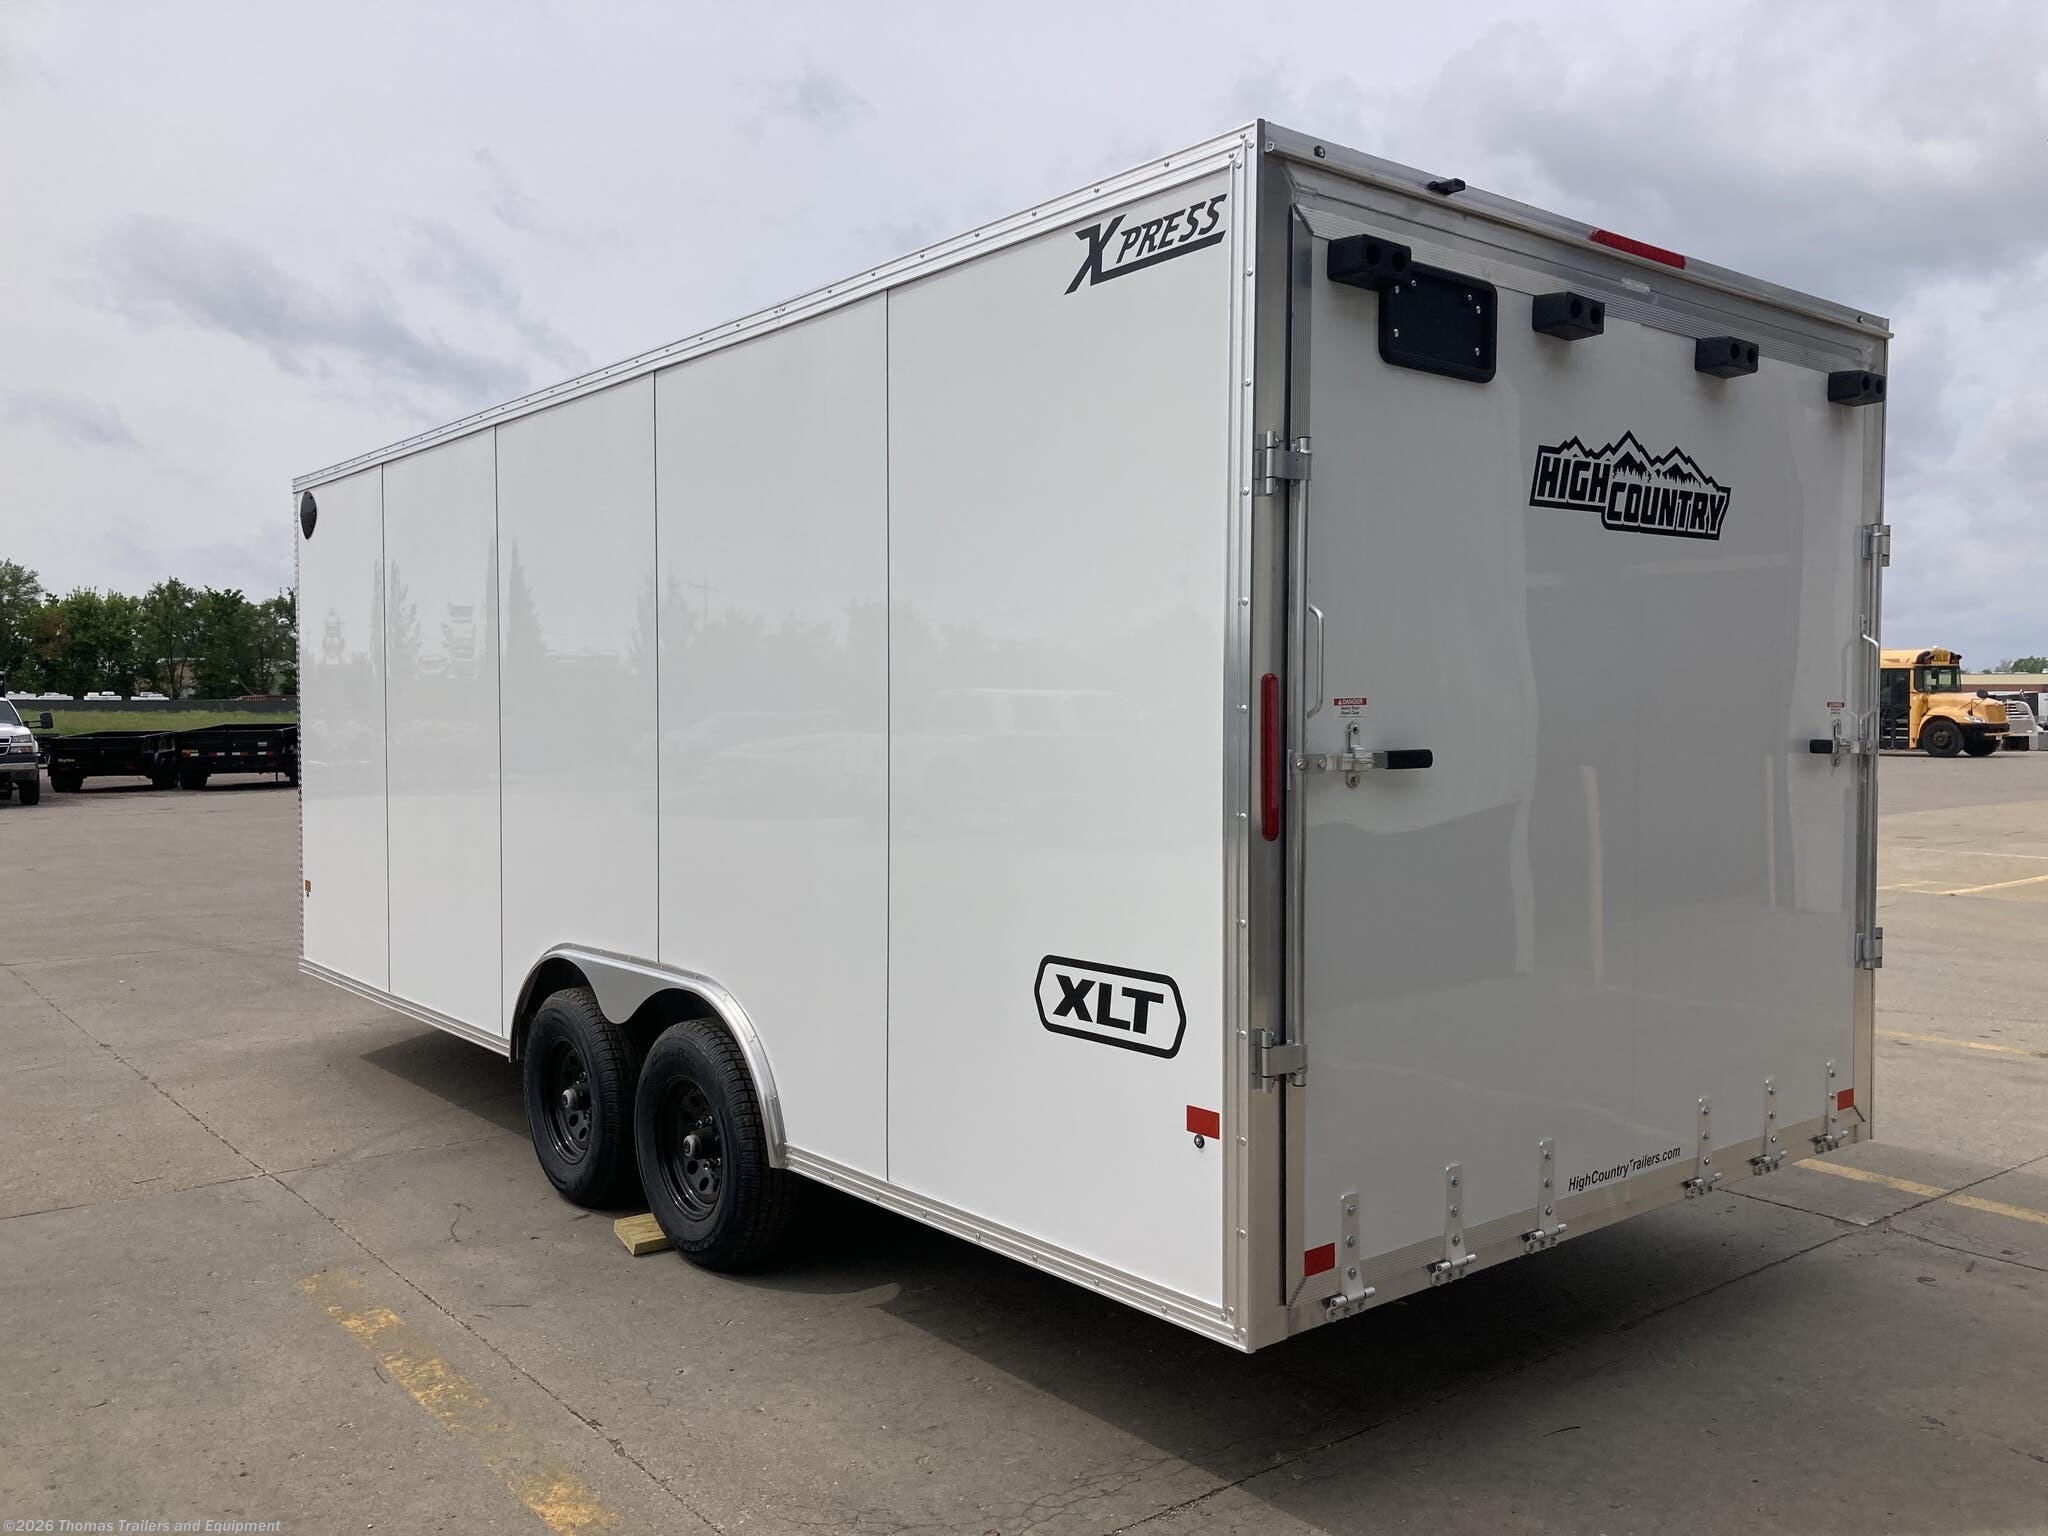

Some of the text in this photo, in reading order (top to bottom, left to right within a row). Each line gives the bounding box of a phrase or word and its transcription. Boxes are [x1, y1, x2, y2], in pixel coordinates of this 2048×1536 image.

[1536, 455, 1612, 503] HIGH
[1605, 481, 1726, 533] COUNTRY
[1052, 973, 1165, 1035] XLT
[1568, 1147, 1681, 1192] HighCountryTrailers.com
